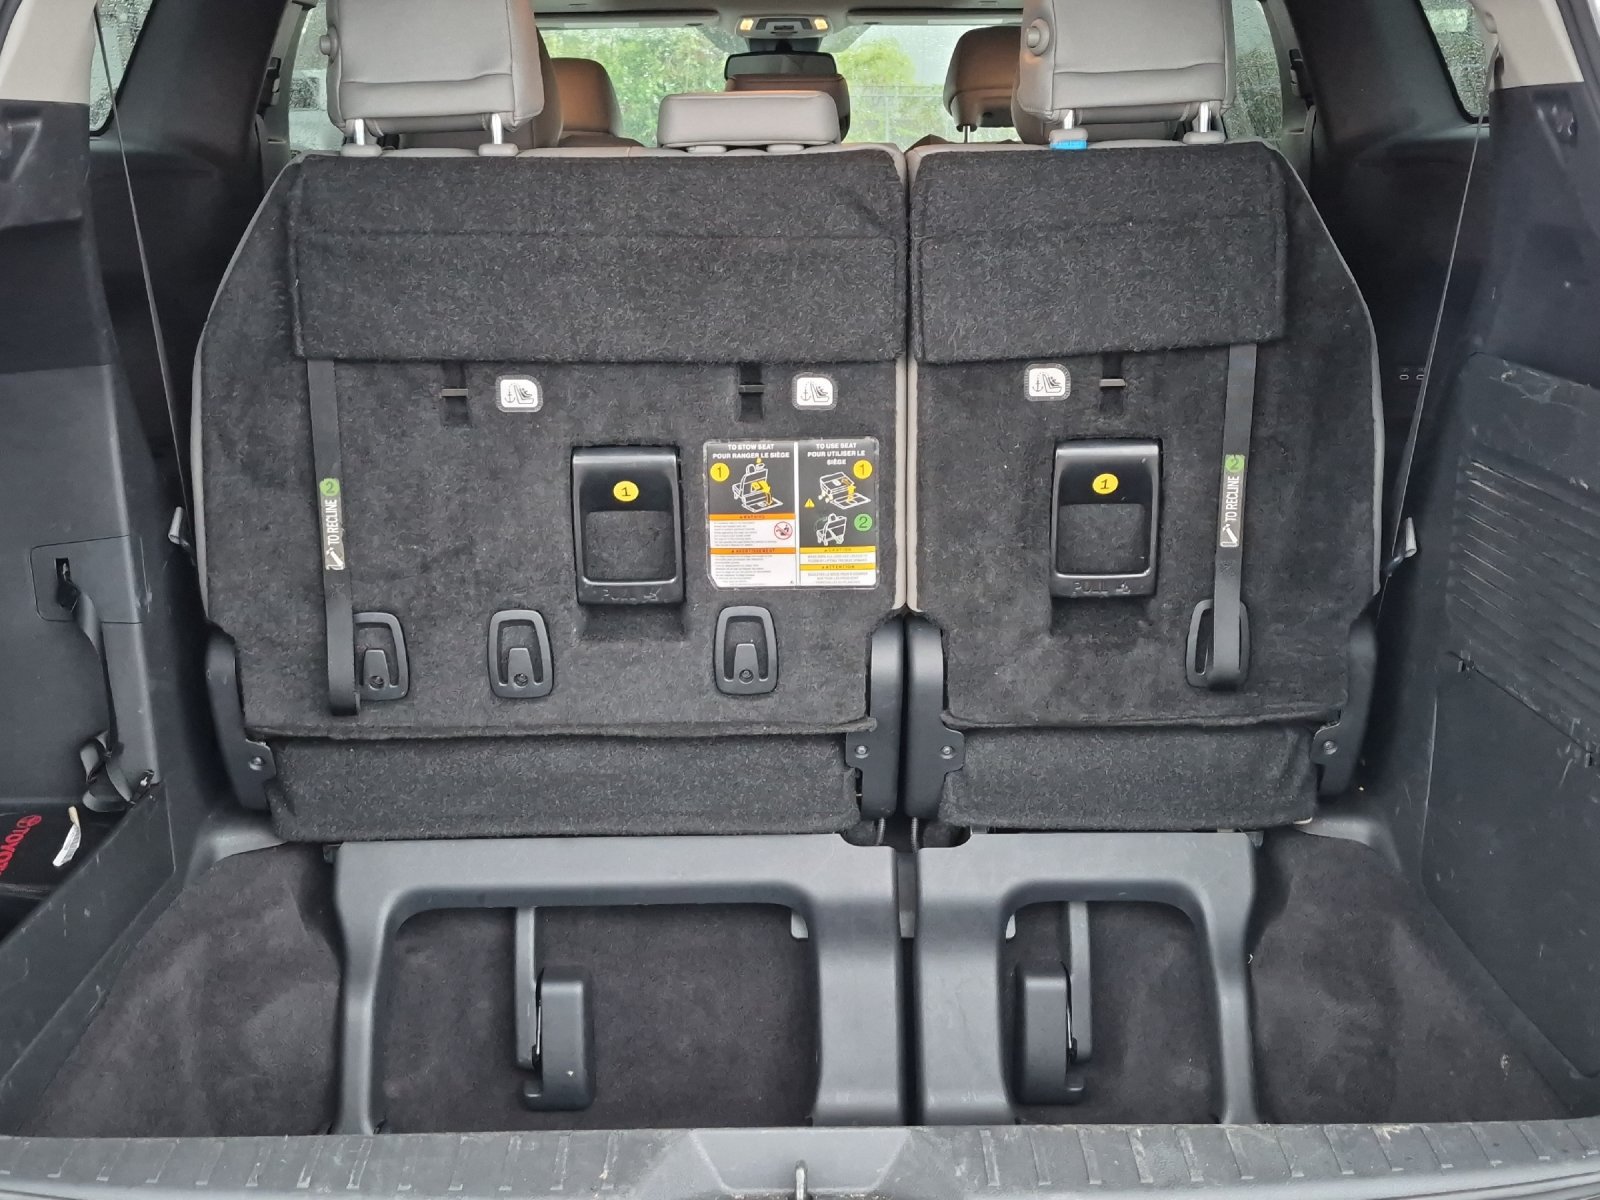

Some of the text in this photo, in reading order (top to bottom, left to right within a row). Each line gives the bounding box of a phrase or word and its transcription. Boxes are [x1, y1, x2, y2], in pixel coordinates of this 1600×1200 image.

[1230, 459, 1239, 470] 2
[326, 481, 335, 494] 2
[1100, 479, 1110, 490] 1
[621, 487, 631, 497] 1
[1225, 476, 1239, 522] TO RECLINE
[325, 499, 340, 545] TO RECLINE
[858, 516, 868, 528] 2
